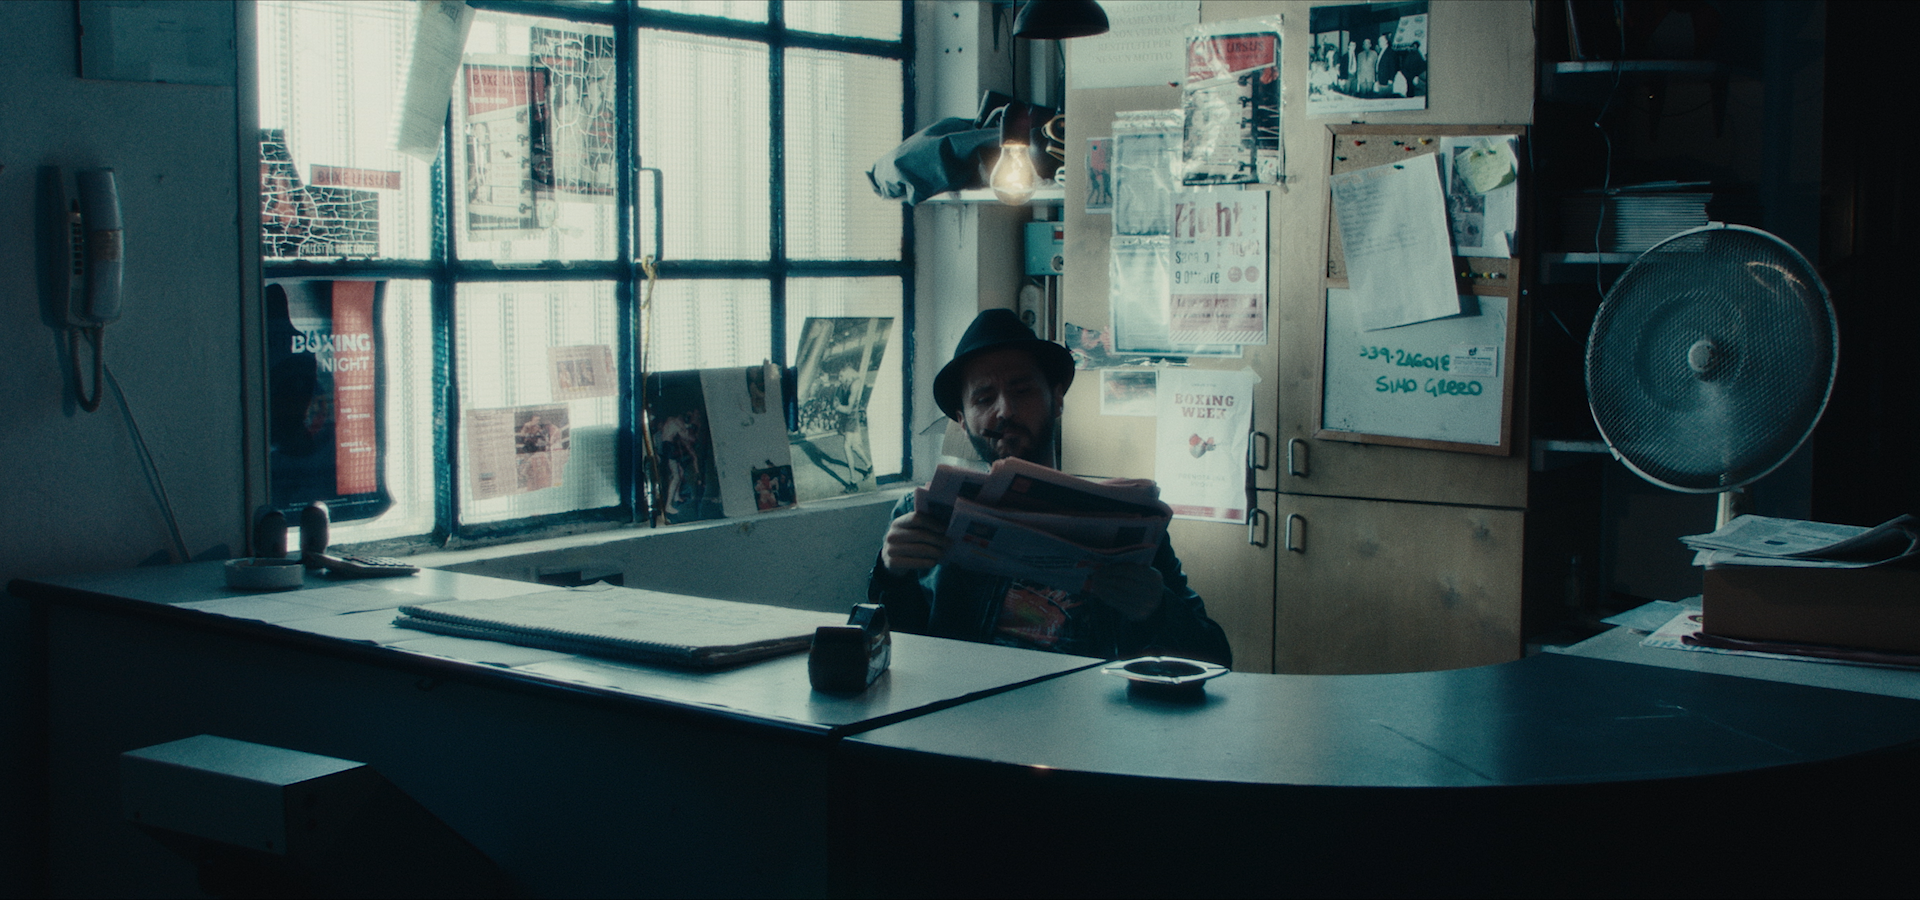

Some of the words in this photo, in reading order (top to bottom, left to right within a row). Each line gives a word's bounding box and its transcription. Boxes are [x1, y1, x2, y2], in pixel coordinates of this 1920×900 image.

[1226, 41, 1264, 53] URSUS
[473, 74, 498, 86] BOXE
[317, 170, 348, 184] BOXE
[352, 172, 391, 186] URSUS
[1175, 270, 1182, 284] 9
[291, 333, 371, 354] BOXING
[322, 356, 370, 372] NIGHT
[1376, 375, 1418, 394] SIMO
[1174, 393, 1235, 407] BOXING
[1181, 406, 1227, 420] WEEK
